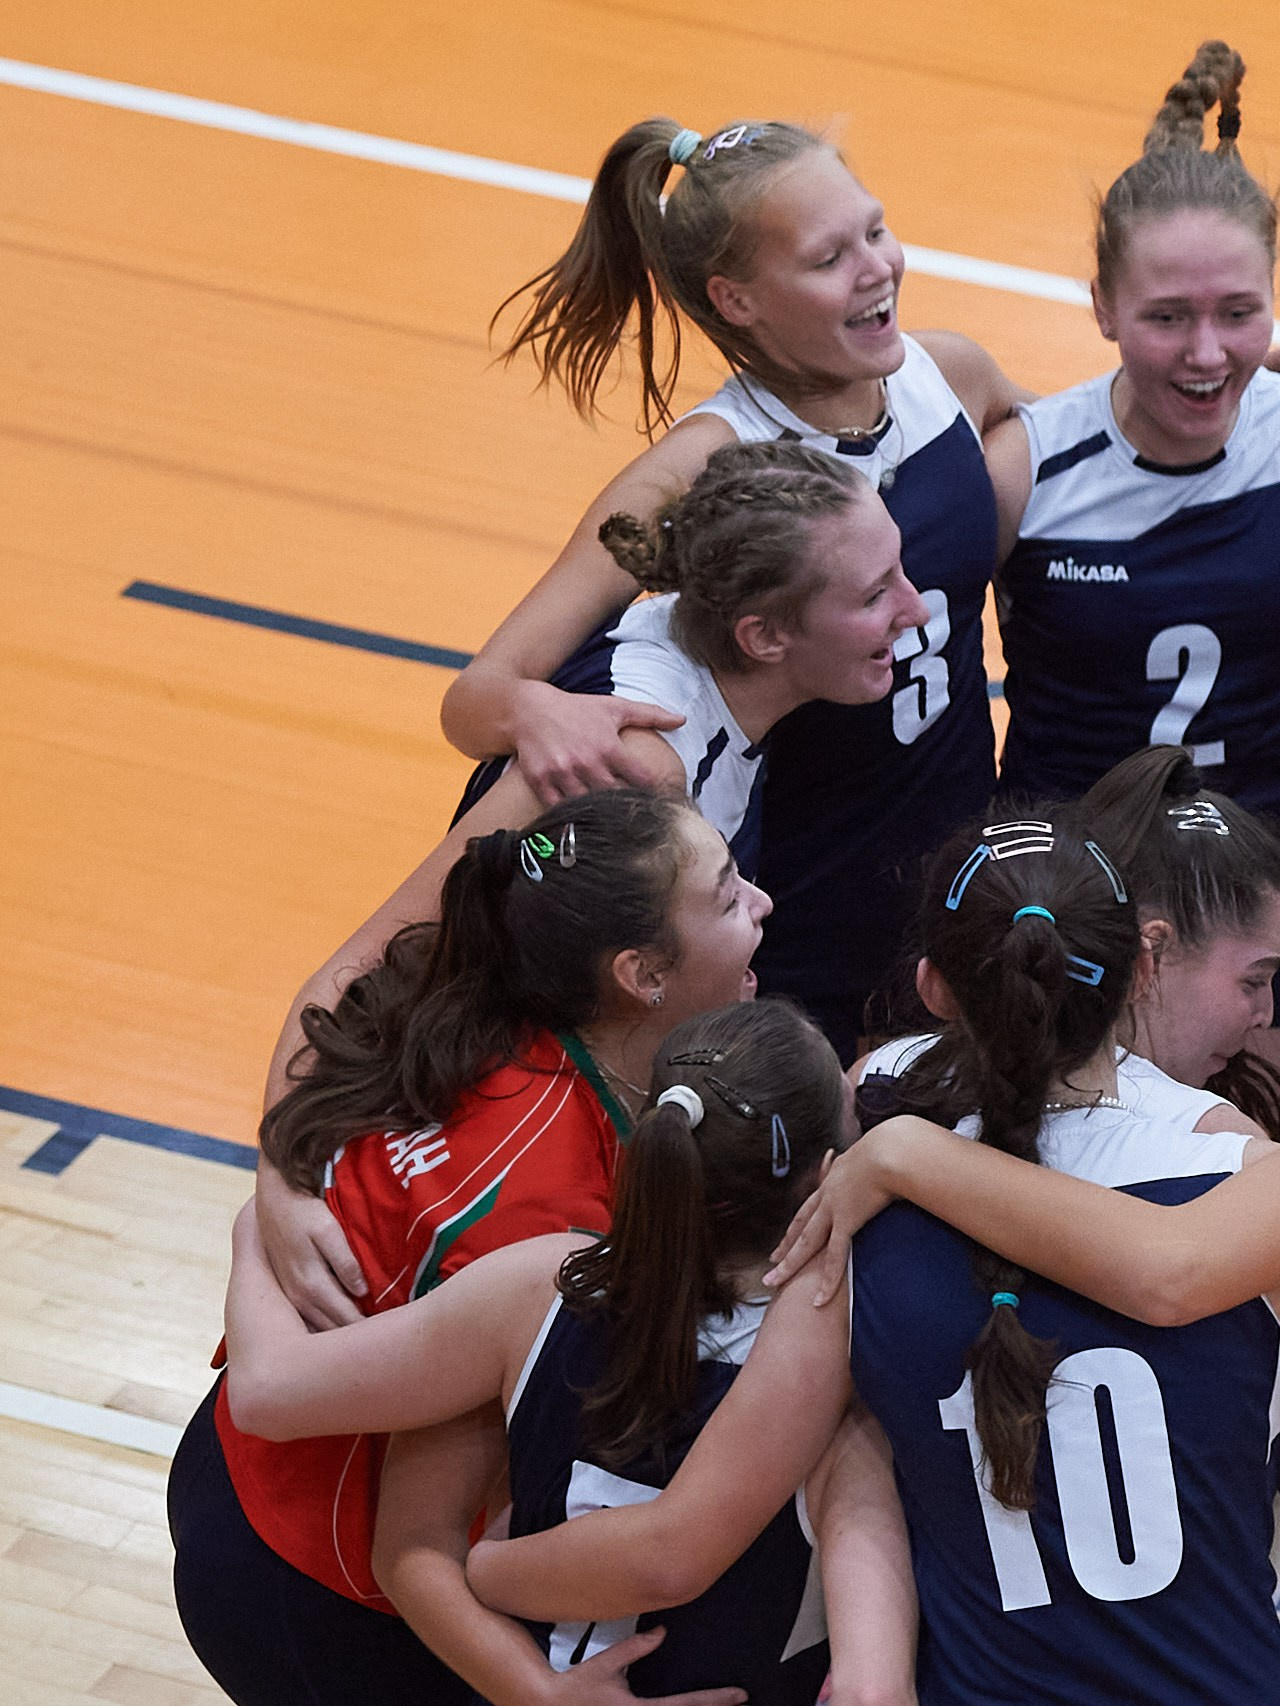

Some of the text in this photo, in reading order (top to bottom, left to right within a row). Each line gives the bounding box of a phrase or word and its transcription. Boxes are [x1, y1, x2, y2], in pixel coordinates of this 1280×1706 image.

[892, 588, 951, 746] 3
[1145, 623, 1226, 768] 2
[937, 1346, 1184, 1612] 10
